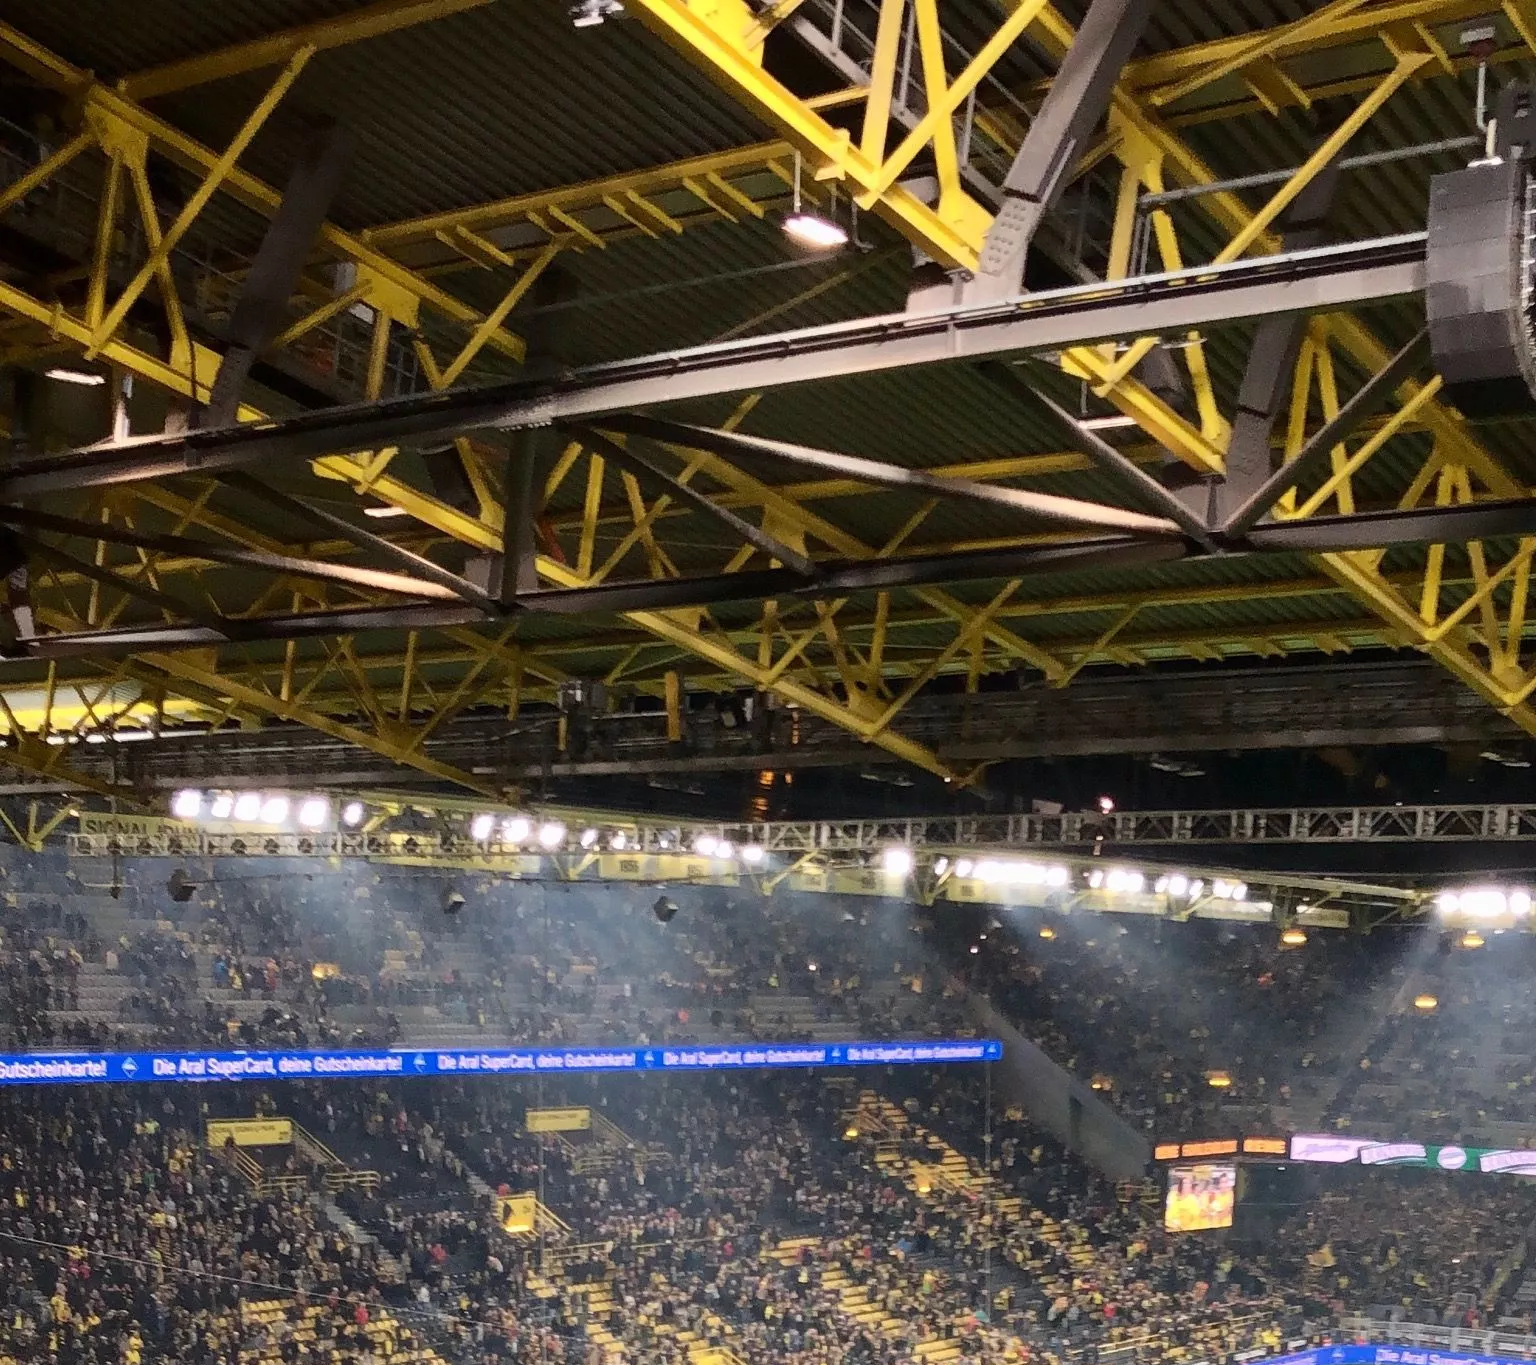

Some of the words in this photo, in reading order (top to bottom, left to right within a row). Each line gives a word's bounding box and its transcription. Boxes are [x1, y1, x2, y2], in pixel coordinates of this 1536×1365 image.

[153, 1058, 176, 1075] Die
[179, 1058, 205, 1075] Aral
[208, 1057, 277, 1079] SuperCard,
[278, 1057, 312, 1073] deine
[313, 1056, 403, 1072] Gutscheinkarte!
[438, 1054, 456, 1070] Die
[458, 1054, 479, 1070] Aral
[480, 1054, 535, 1072] SuperCard,
[536, 1054, 563, 1068] deine
[564, 1052, 636, 1068] Gutscheinkarte!
